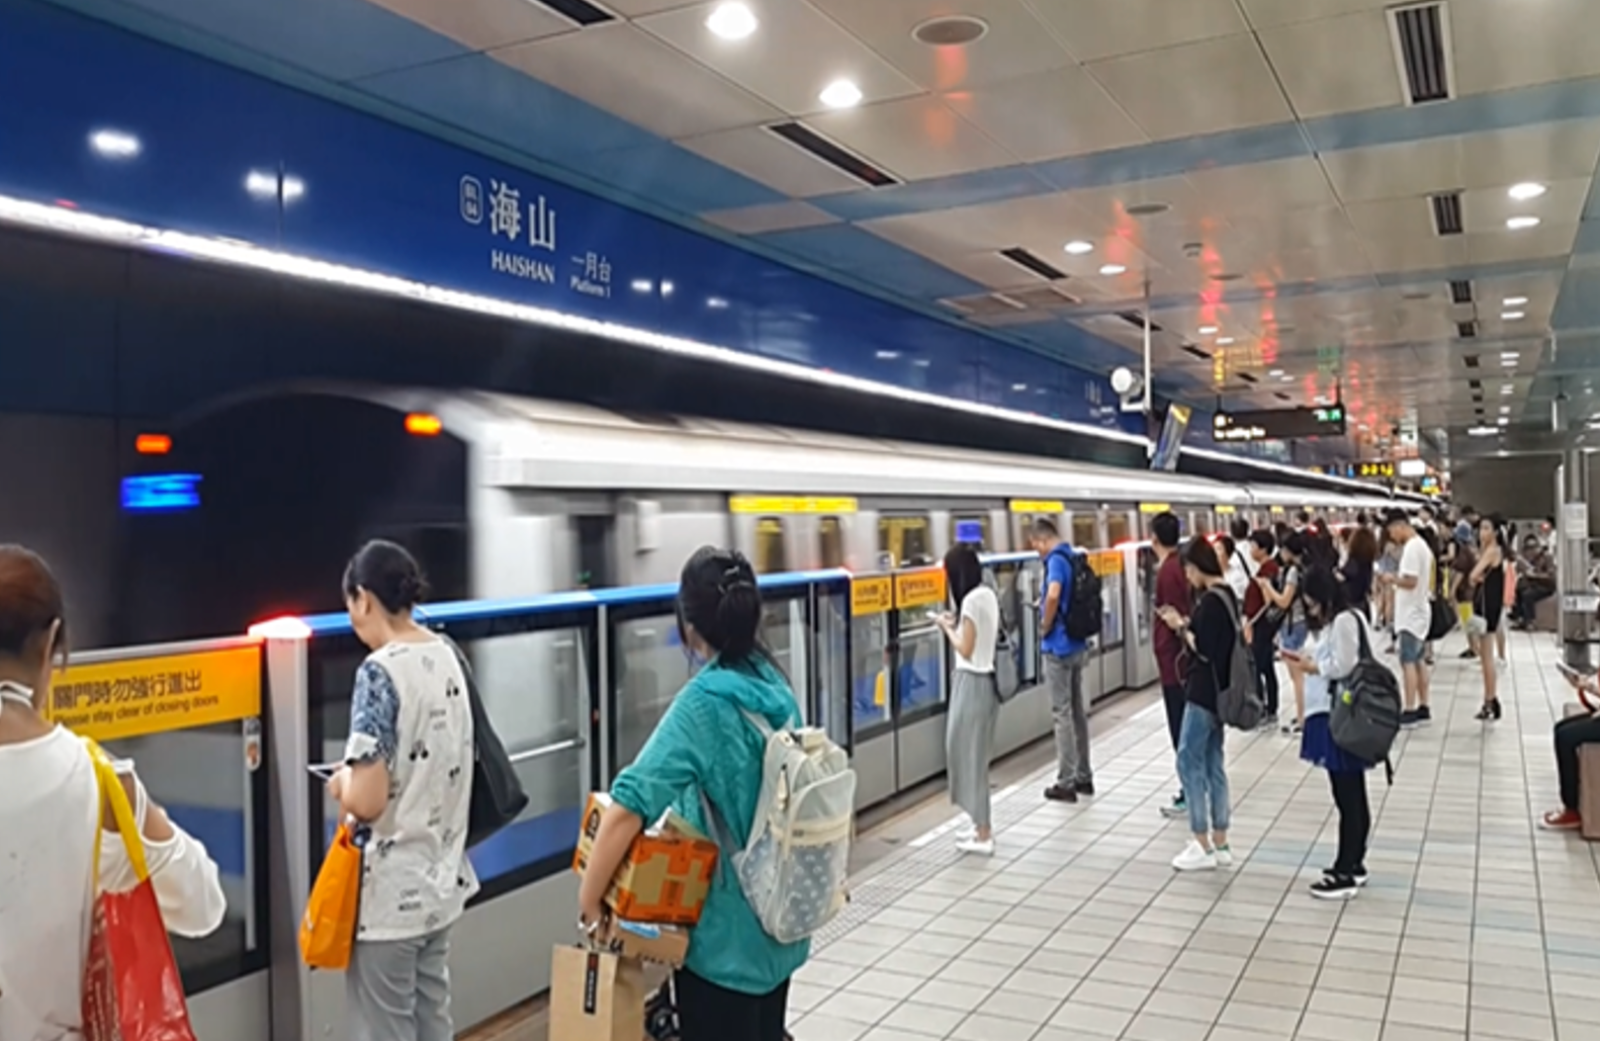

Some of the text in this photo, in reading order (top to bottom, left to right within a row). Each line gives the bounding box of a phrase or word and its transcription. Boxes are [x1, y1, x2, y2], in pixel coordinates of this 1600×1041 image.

[488, 178, 555, 251] 海山
[491, 249, 555, 284] HAISHAN
[571, 251, 612, 283] 一月台
[93, 710, 114, 724] stay
[116, 706, 140, 720] clear
[143, 703, 154, 715] of
[155, 699, 190, 713] closing
[192, 695, 219, 709] doors
